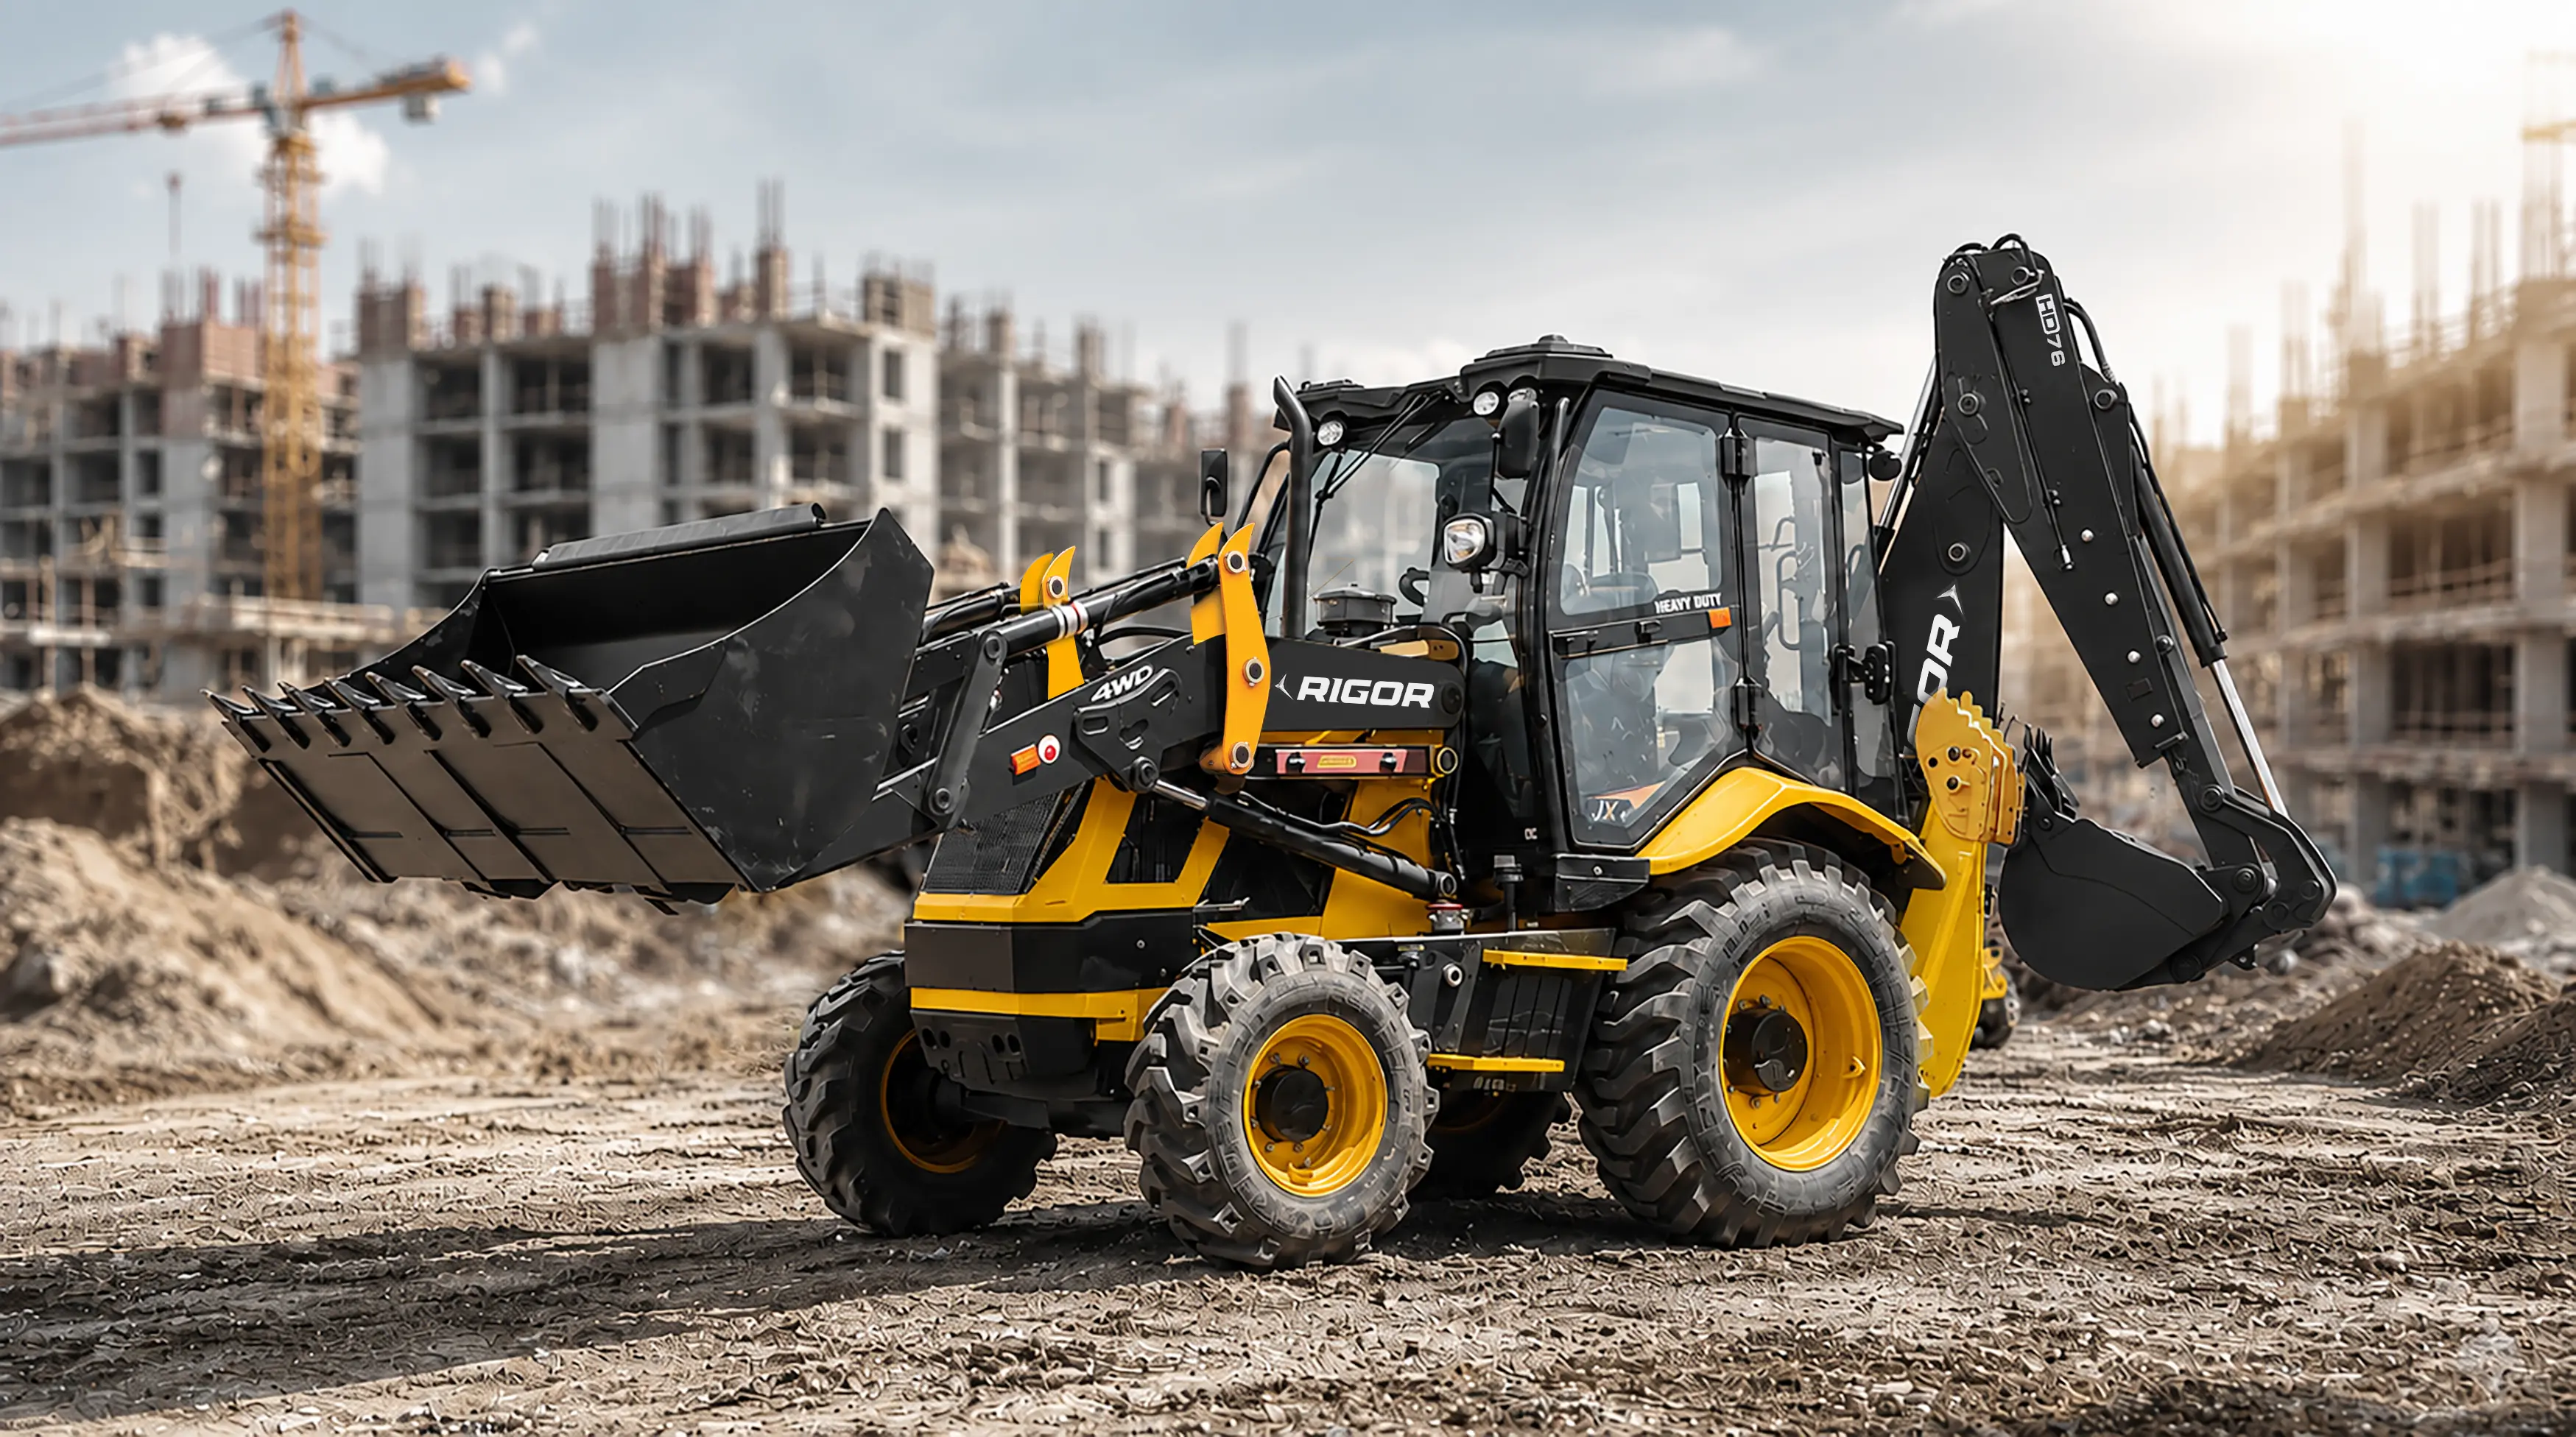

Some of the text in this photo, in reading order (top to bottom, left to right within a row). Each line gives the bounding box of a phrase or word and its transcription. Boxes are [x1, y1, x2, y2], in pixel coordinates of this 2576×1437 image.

[2035, 293, 2066, 367] HD76
[1654, 591, 1722, 614] HEAVY DUTY
[1091, 665, 1154, 702] 4WD
[1296, 676, 1435, 708] RIGOR
